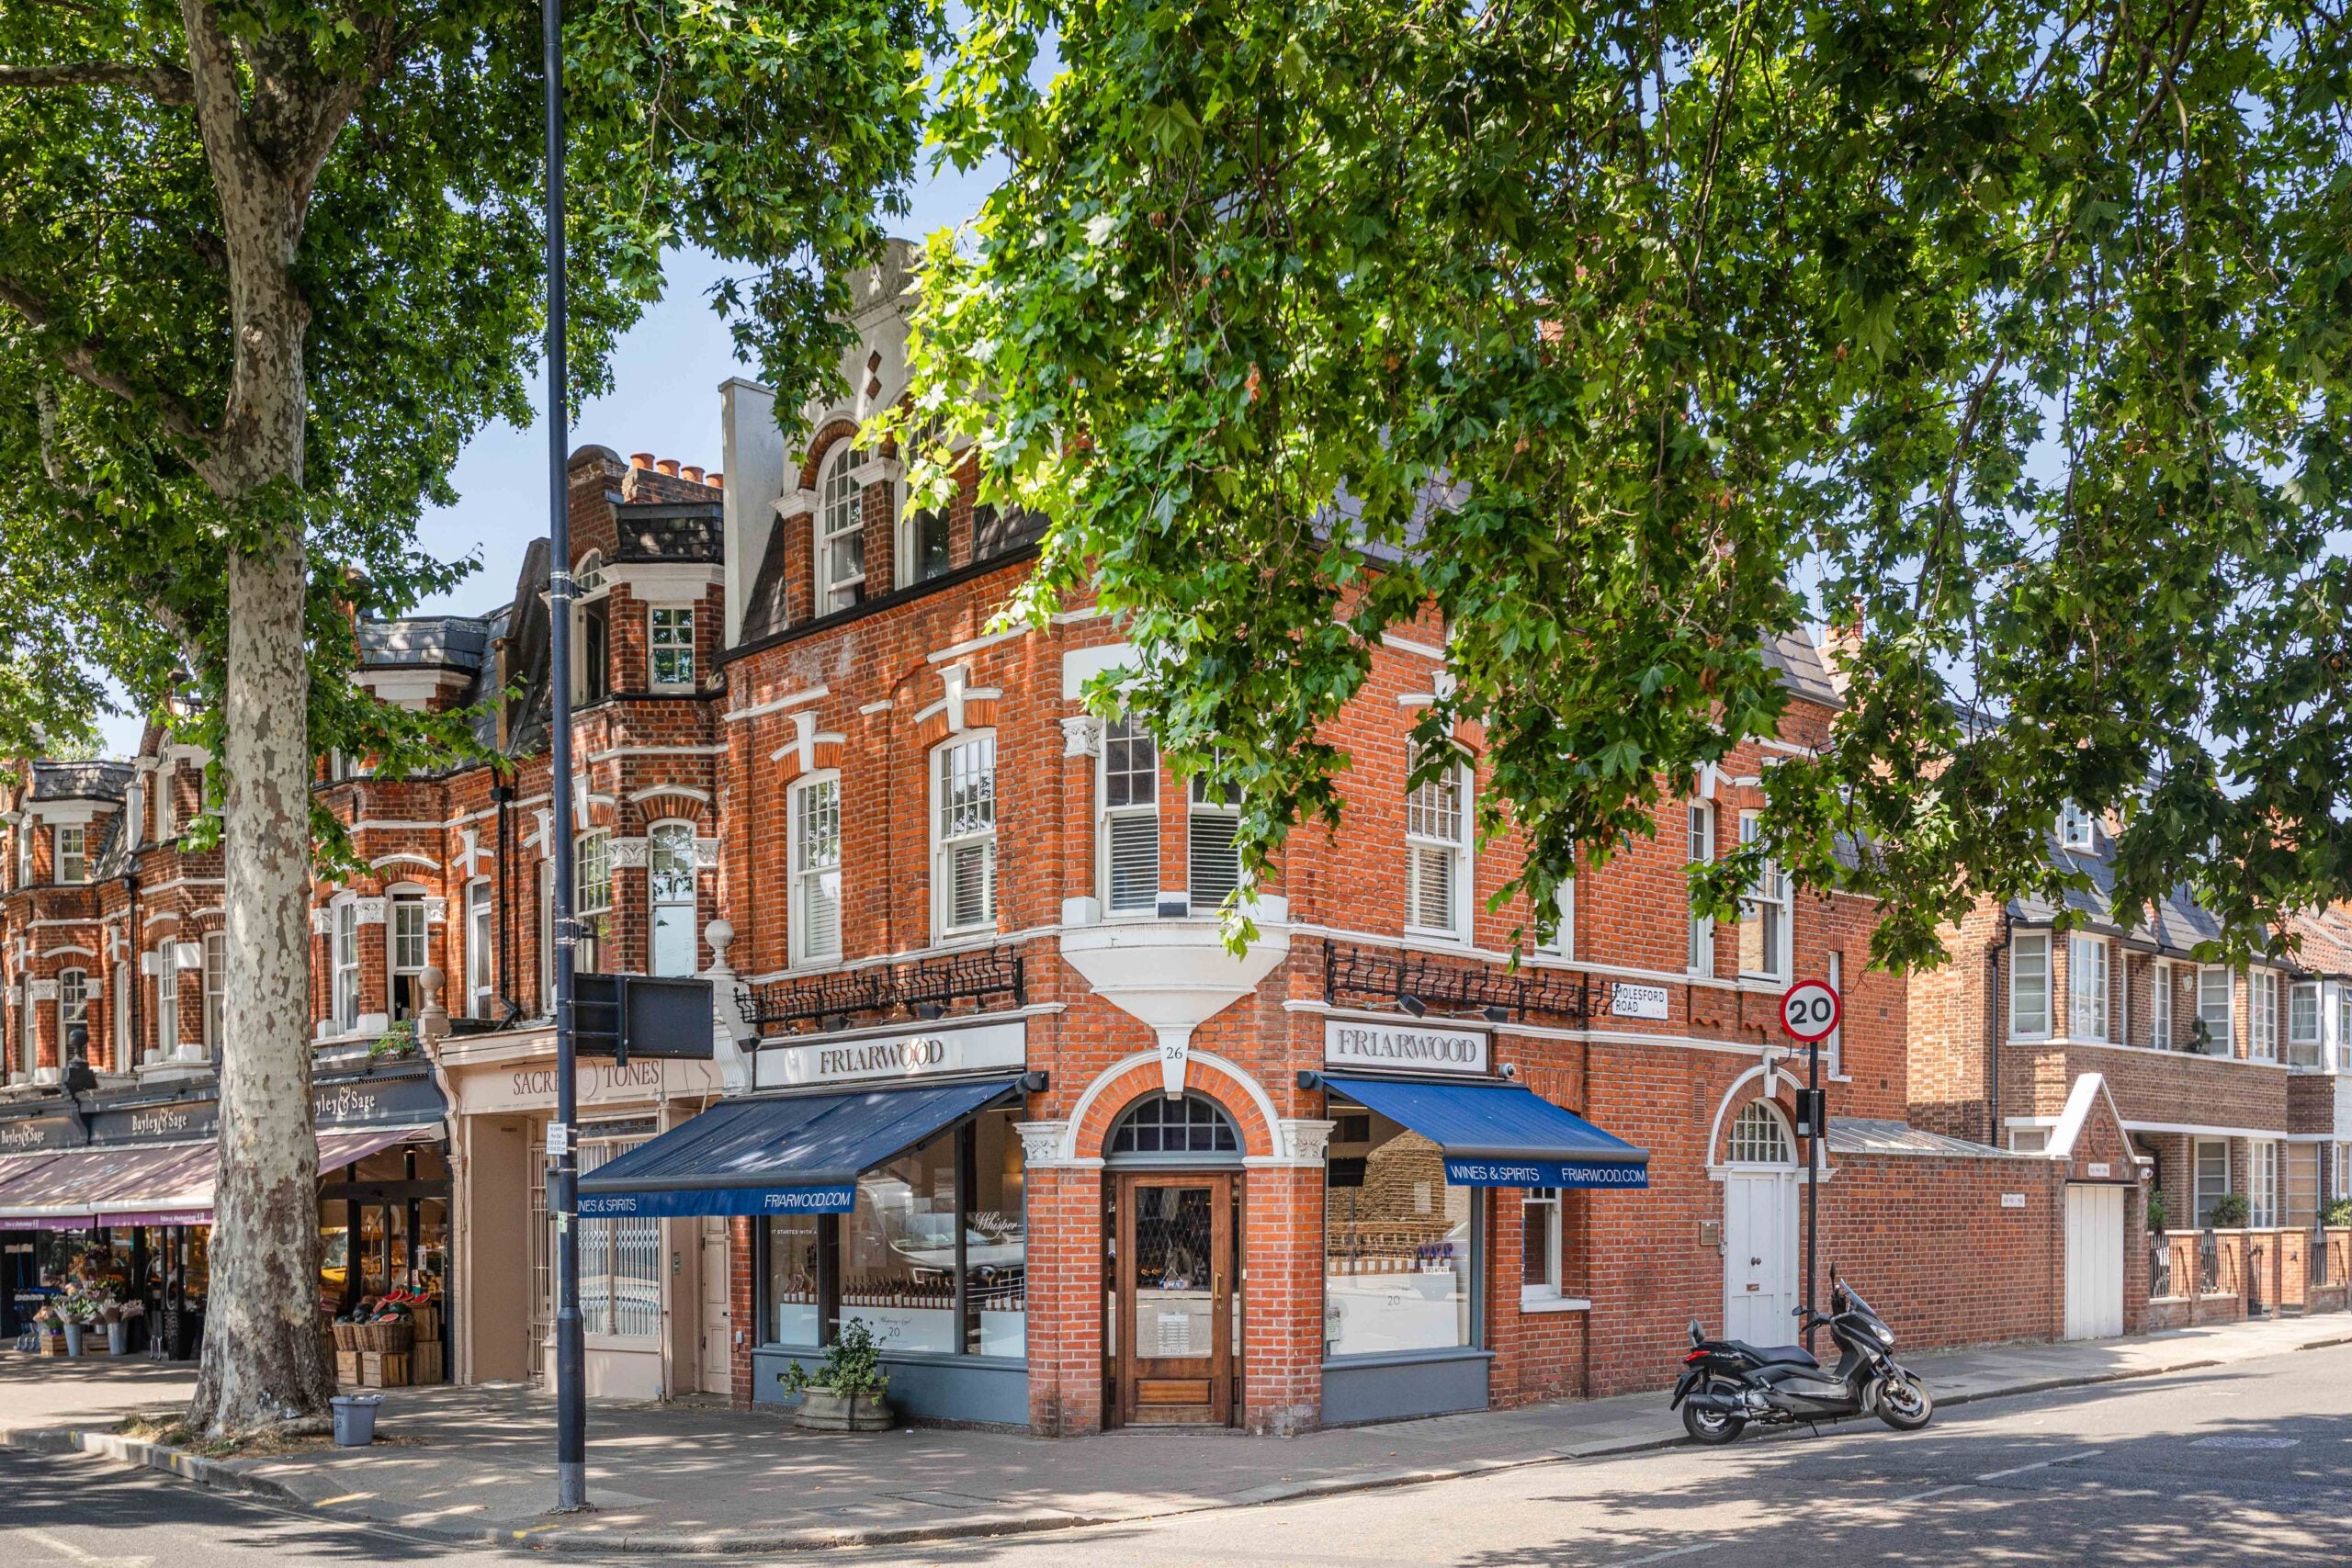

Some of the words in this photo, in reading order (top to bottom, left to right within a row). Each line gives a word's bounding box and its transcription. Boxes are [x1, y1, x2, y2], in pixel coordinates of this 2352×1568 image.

[1615, 987, 1664, 1002] MOLESFORD
[1615, 999, 1638, 1012] ROAD
[1789, 997, 1831, 1024] 20
[1166, 1046, 1182, 1059] 26
[1338, 1029, 1477, 1063] FRIARWOOD
[820, 1039, 945, 1074] FRIARWOOD
[351, 1090, 376, 1111] Sage
[131, 1113, 159, 1132] Bayley
[168, 1111, 187, 1131] Sage
[1, 1130, 24, 1146] Bayley
[29, 1126, 45, 1142] Sage
[1451, 1166, 1487, 1180] WINES
[1489, 1167, 1499, 1180] &
[1499, 1168, 1540, 1181] SPIRITS
[1562, 1168, 1645, 1183] FRIARWOOD.COM
[598, 1200, 605, 1212] &
[606, 1198, 637, 1212] SPIRITS
[764, 1191, 851, 1208] FRIARWOOD.COM
[1387, 1295, 1400, 1306] 20
[888, 1326, 900, 1337] 20
